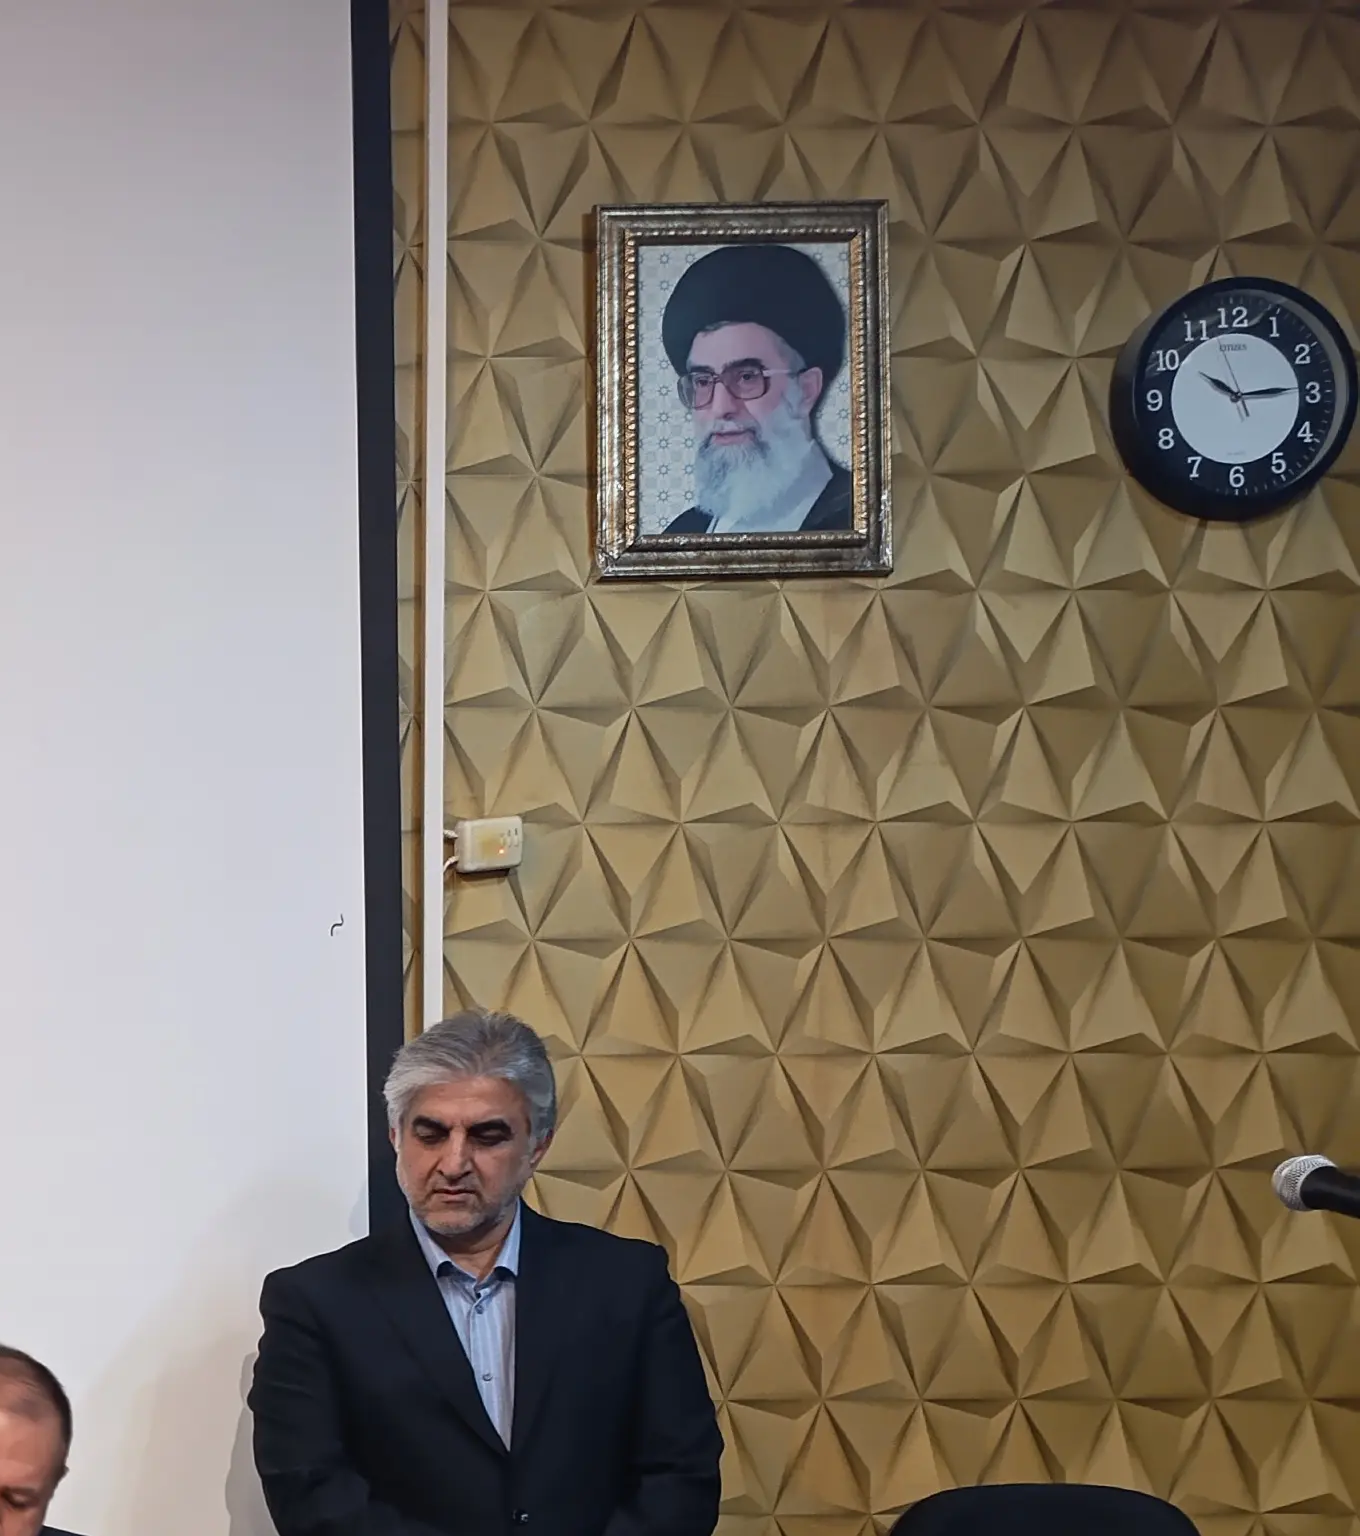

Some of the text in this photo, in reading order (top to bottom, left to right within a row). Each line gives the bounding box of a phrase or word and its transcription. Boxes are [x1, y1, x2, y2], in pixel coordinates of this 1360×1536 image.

[1217, 306, 1249, 329] 12
[1269, 317, 1280, 337] 1
[1184, 319, 1210, 342] 11
[1156, 350, 1180, 371] 10
[1294, 343, 1311, 365] 2
[1146, 389, 1163, 411] 9
[1305, 382, 1321, 403] 3
[1158, 428, 1175, 450] 8
[1297, 421, 1314, 443] 4
[1187, 456, 1202, 478] 7
[1271, 453, 1287, 474] 5
[1229, 466, 1245, 488] 6
